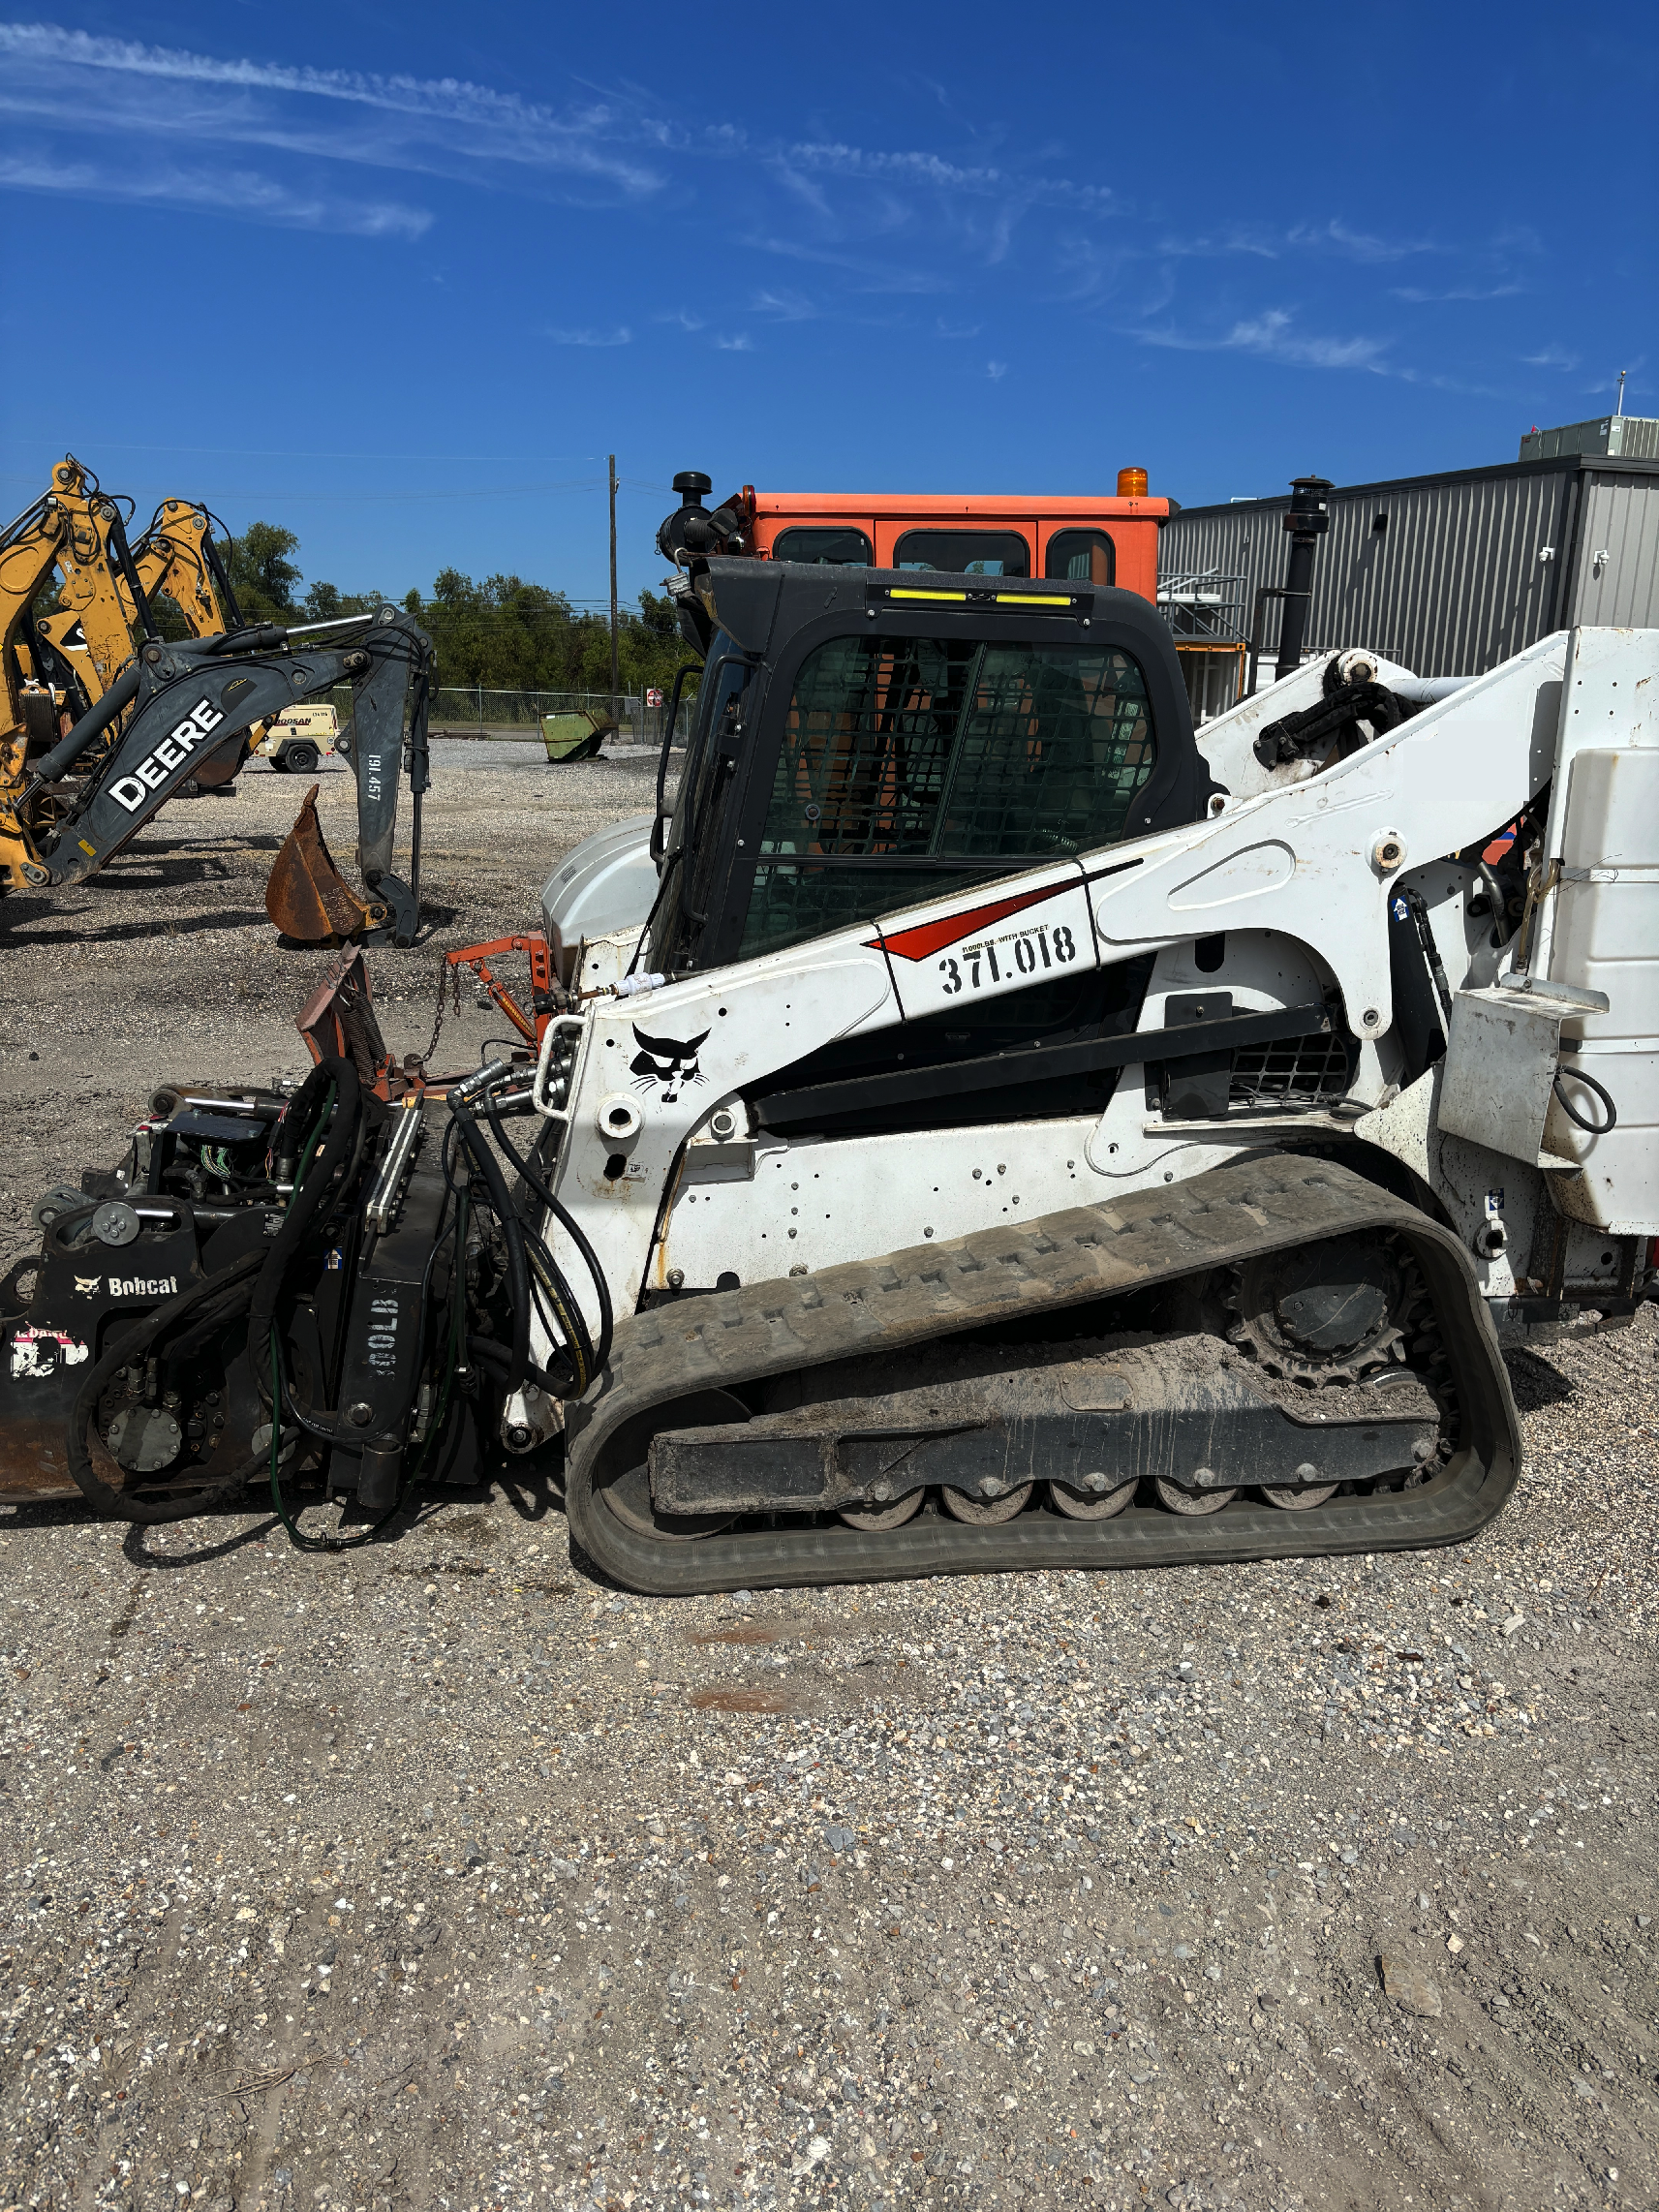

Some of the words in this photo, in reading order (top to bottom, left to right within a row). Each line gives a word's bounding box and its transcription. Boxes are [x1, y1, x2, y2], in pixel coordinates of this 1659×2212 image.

[108, 698, 224, 813] DEERE
[368, 754, 382, 802] 191.457
[998, 933, 1018, 943] WITH
[1019, 924, 1049, 938] BUCKET
[938, 926, 1076, 995] 371.018
[108, 1275, 178, 1297] Bobcat
